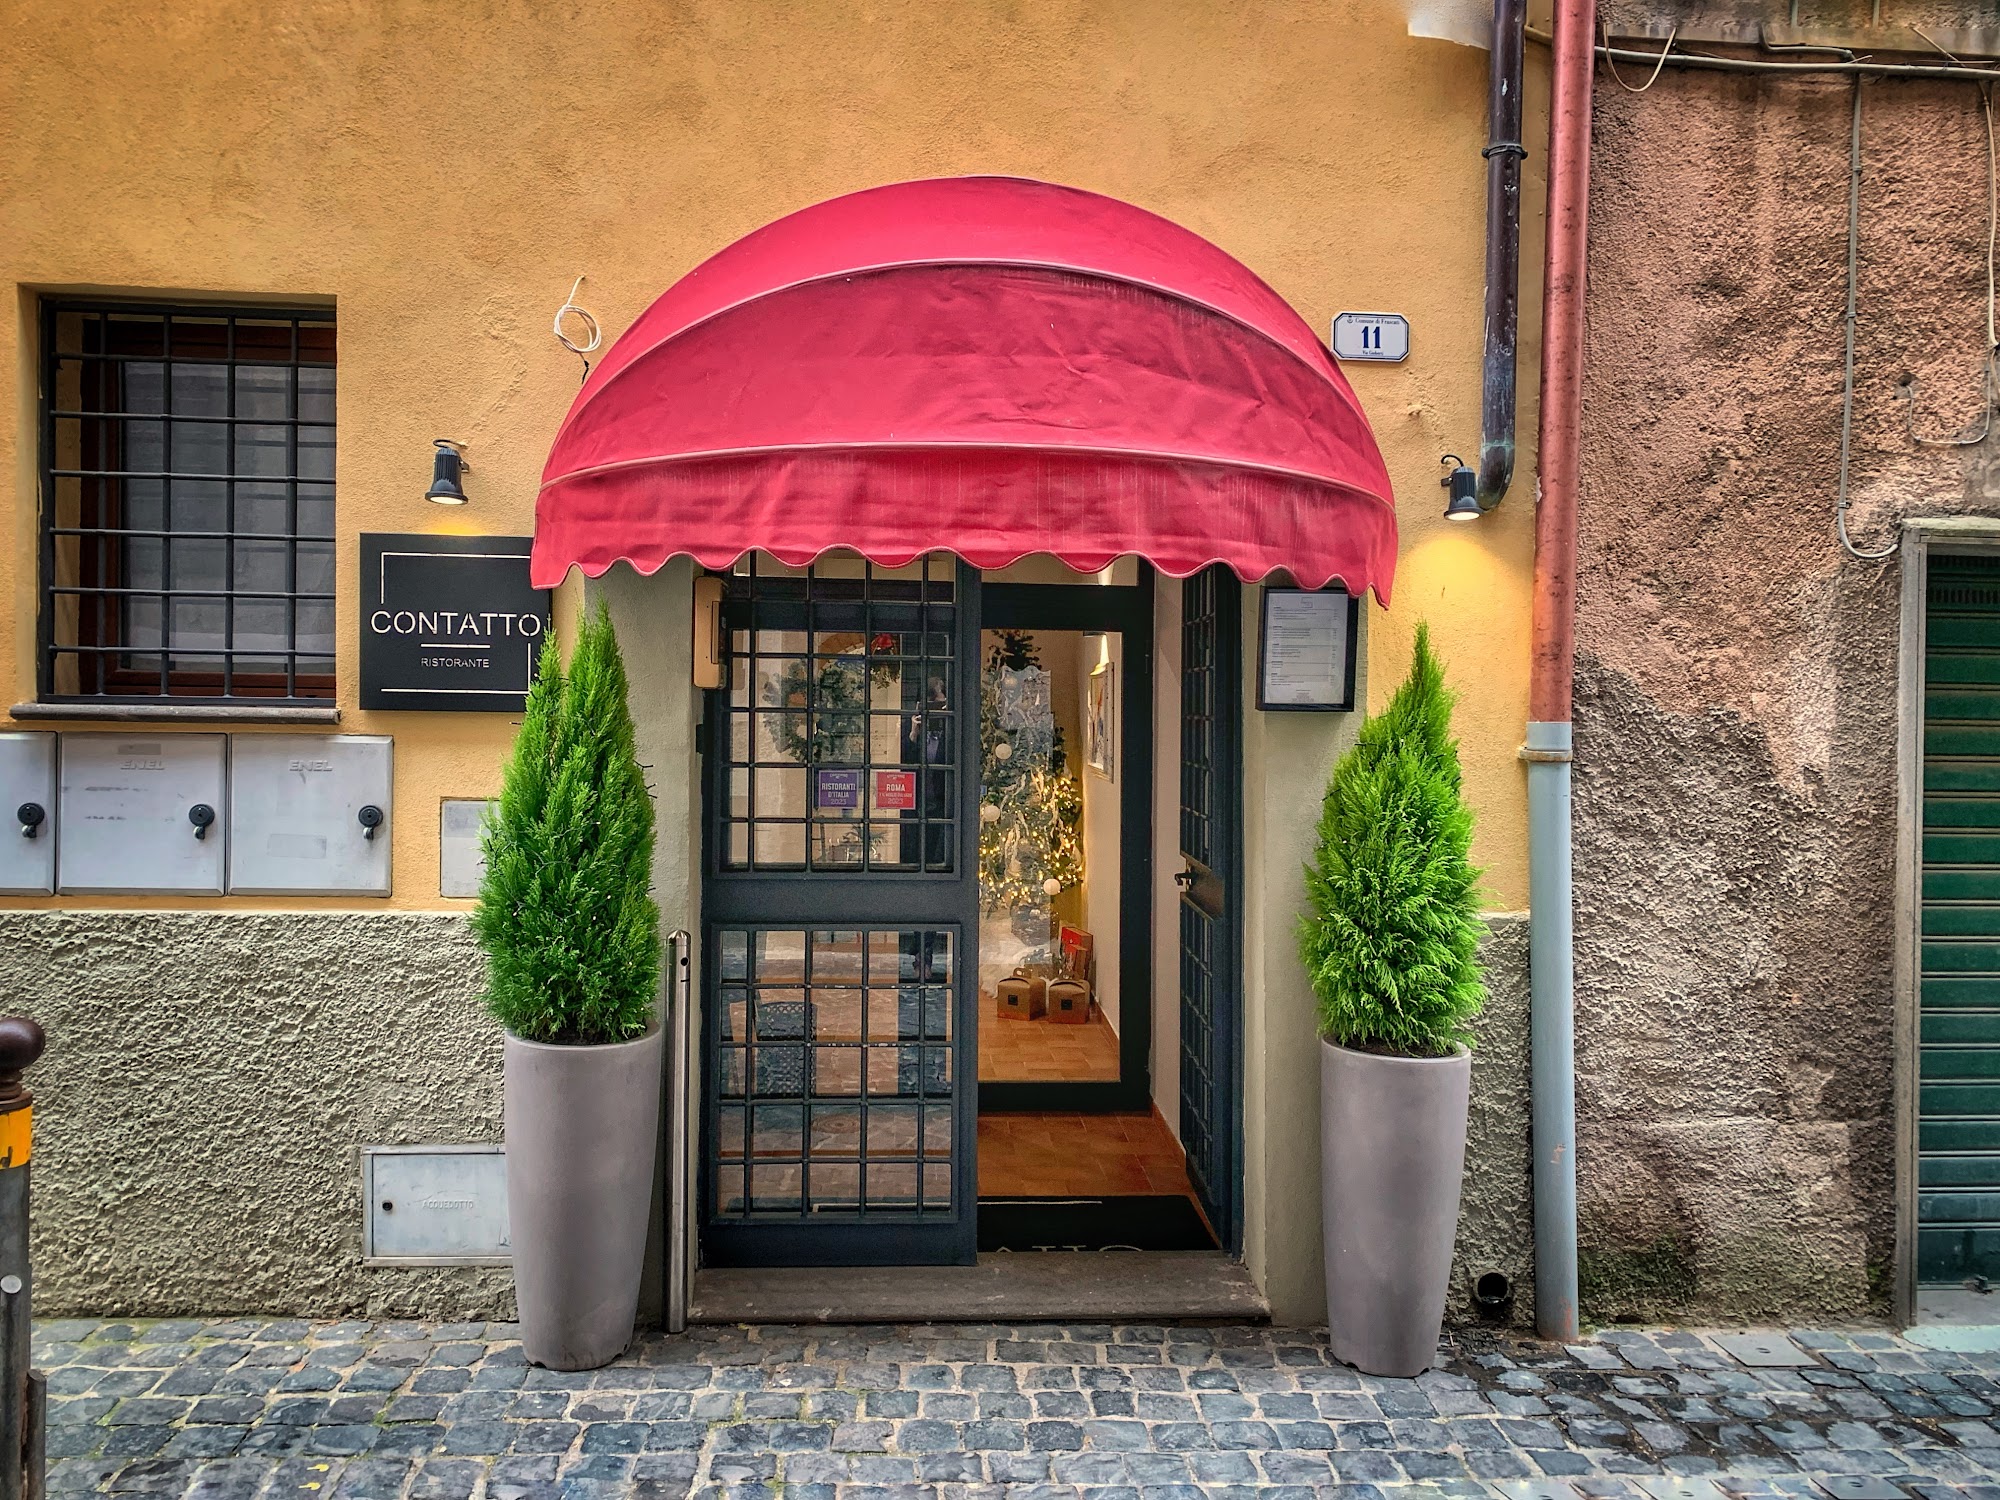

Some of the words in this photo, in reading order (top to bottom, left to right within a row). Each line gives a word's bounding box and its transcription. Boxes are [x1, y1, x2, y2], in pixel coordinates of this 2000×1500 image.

[1361, 326, 1381, 348] 11
[370, 610, 541, 637] CONTATTO
[420, 657, 490, 668] RISTORANTE
[120, 760, 165, 771] ENEL
[288, 759, 334, 772] ENEL
[821, 783, 856, 791] RISTORANTI
[886, 784, 906, 792] ROMA
[421, 1200, 474, 1209] ACQUEDOTTO
